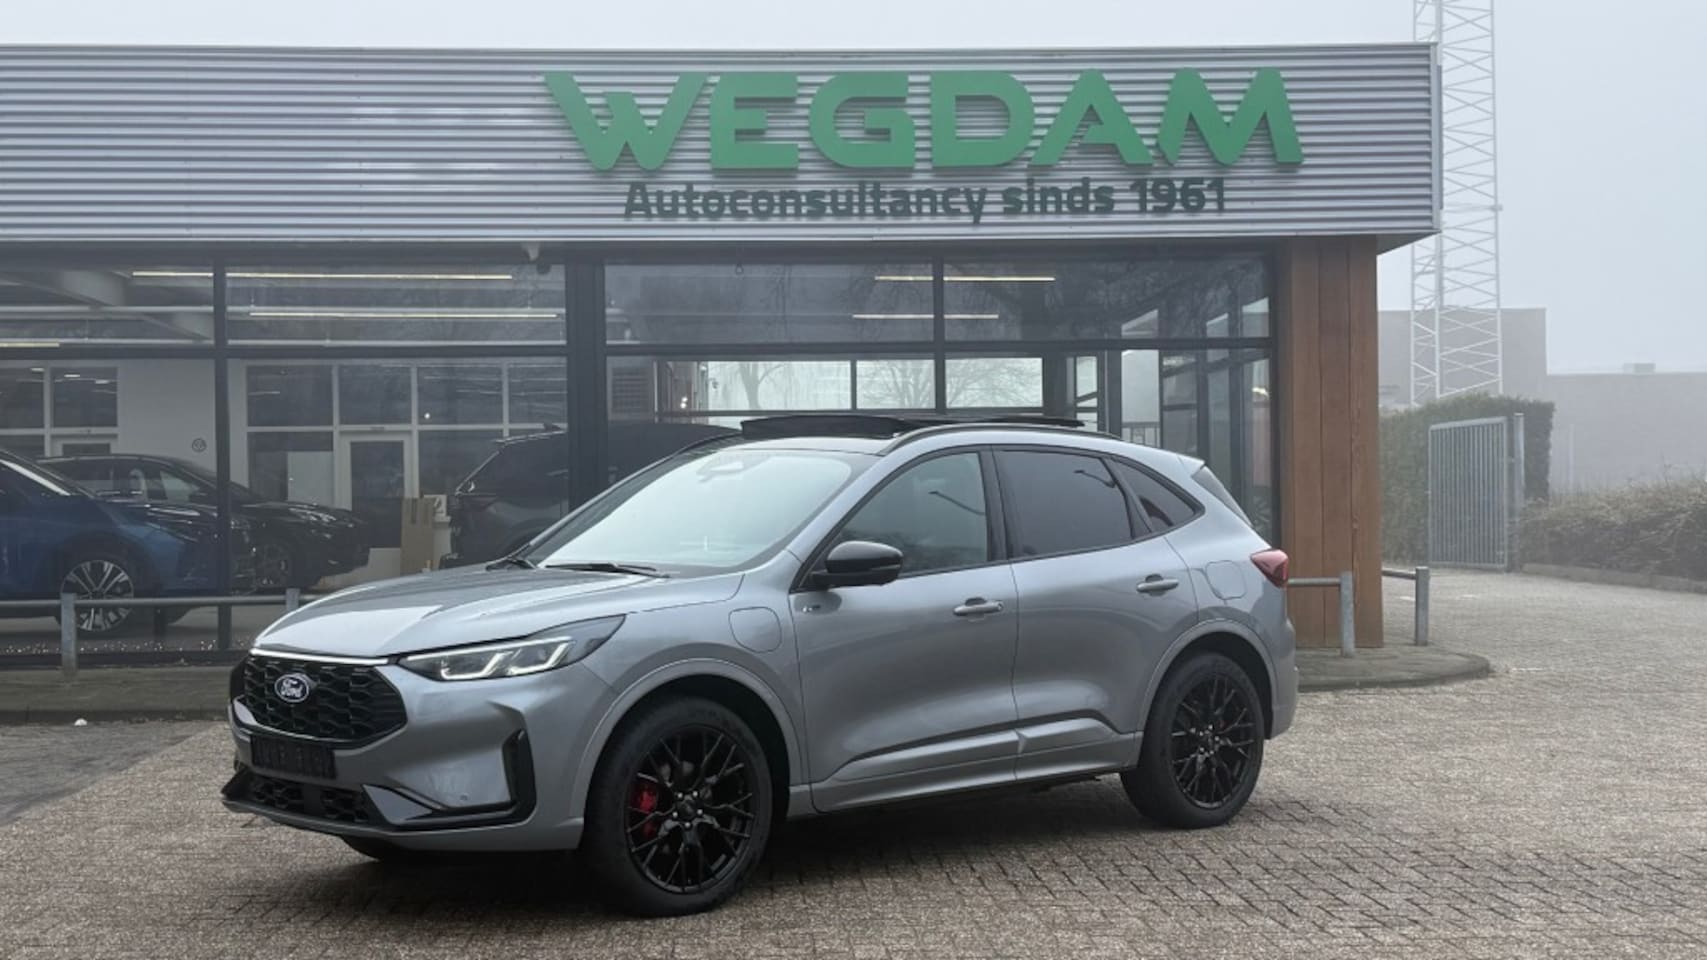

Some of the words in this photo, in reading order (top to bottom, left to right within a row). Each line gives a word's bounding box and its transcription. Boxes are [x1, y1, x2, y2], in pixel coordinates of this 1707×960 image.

[545, 68, 1303, 171] WEGDAM
[626, 182, 987, 225] Autoconsultancy
[1001, 177, 1115, 214] sinds
[1129, 176, 1225, 213] 1961
[280, 678, 304, 698] Ford
